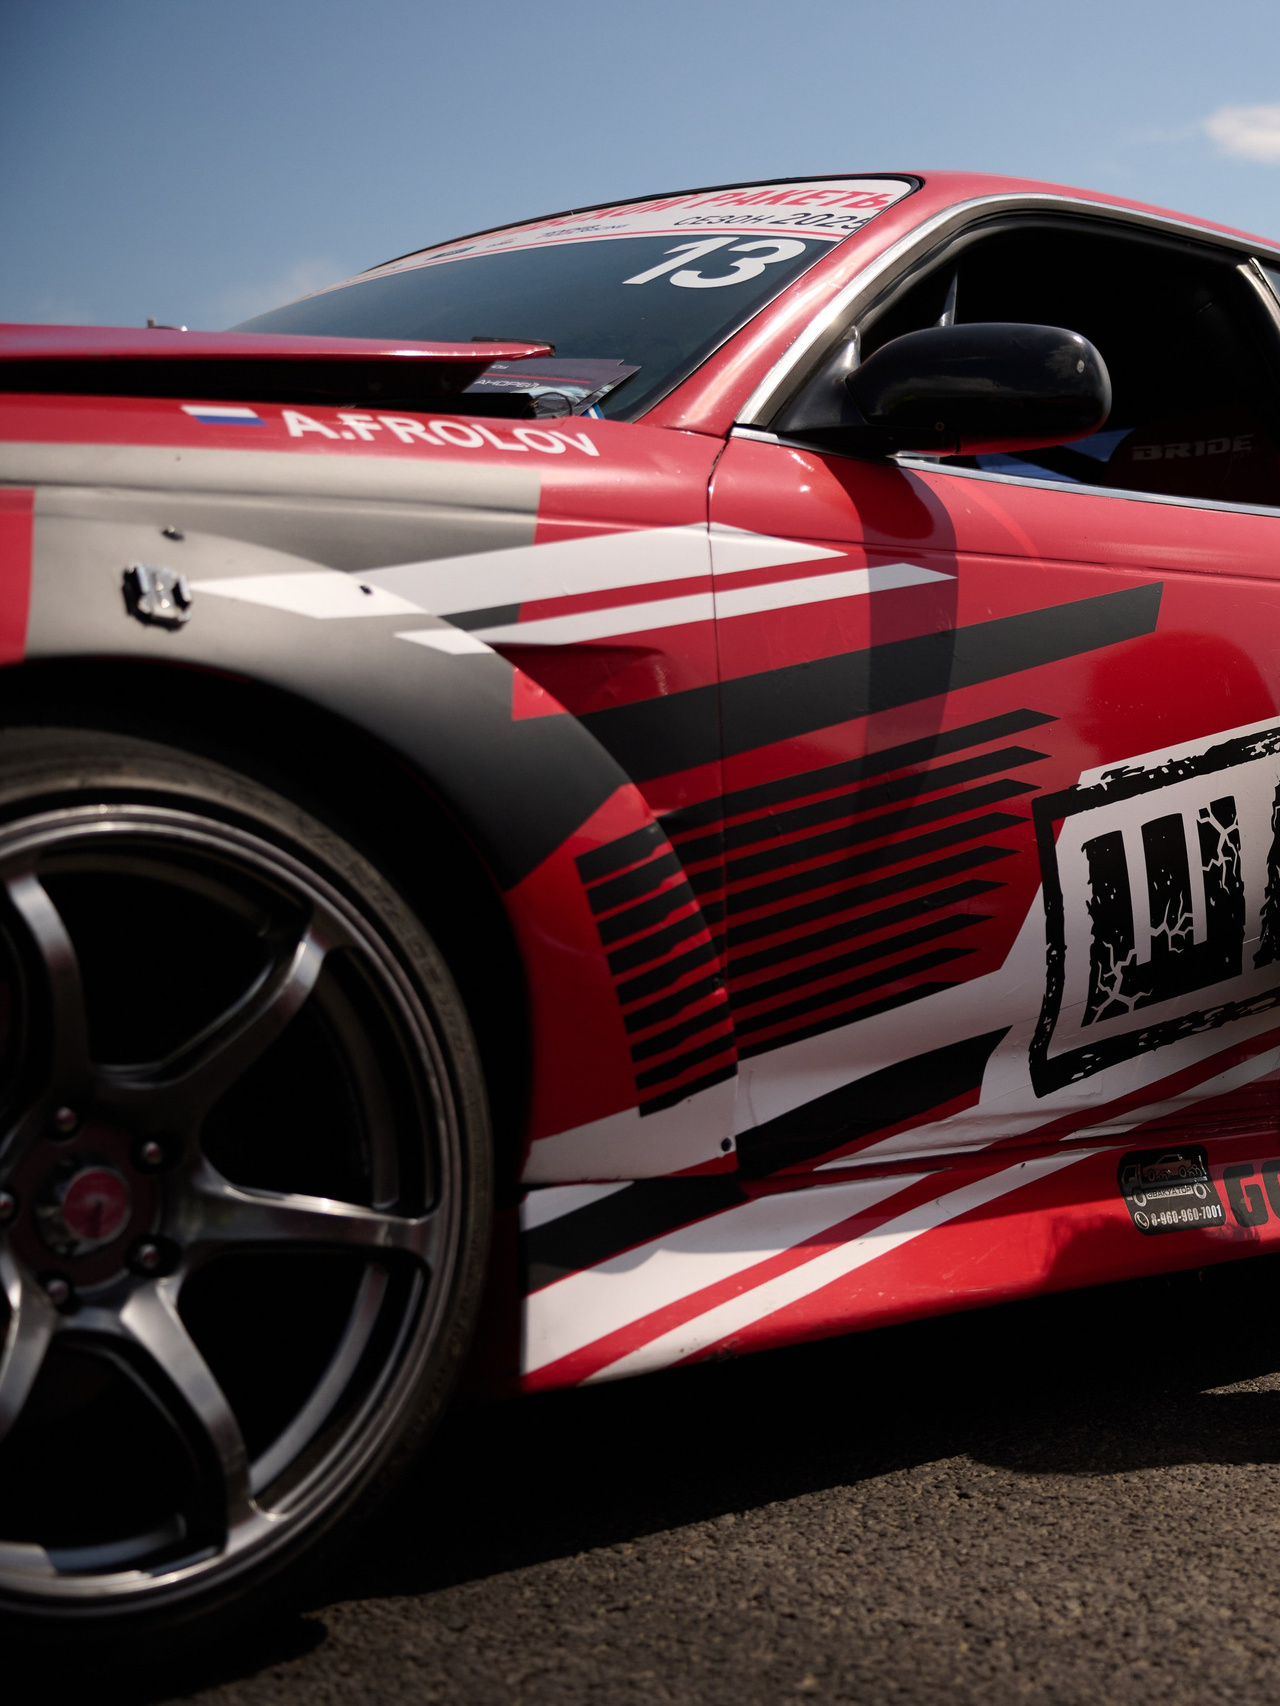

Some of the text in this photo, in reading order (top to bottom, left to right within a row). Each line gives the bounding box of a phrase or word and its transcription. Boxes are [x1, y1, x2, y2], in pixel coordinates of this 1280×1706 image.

[673, 212, 871, 230] СЕЗОН 2025
[622, 236, 807, 289] 13
[282, 410, 600, 457] A.FROLOV
[1131, 433, 1255, 461] BRIDE
[1147, 1185, 1193, 1198] ЭВАКУАТОР
[1150, 1204, 1223, 1227] 8-960-960-7001
